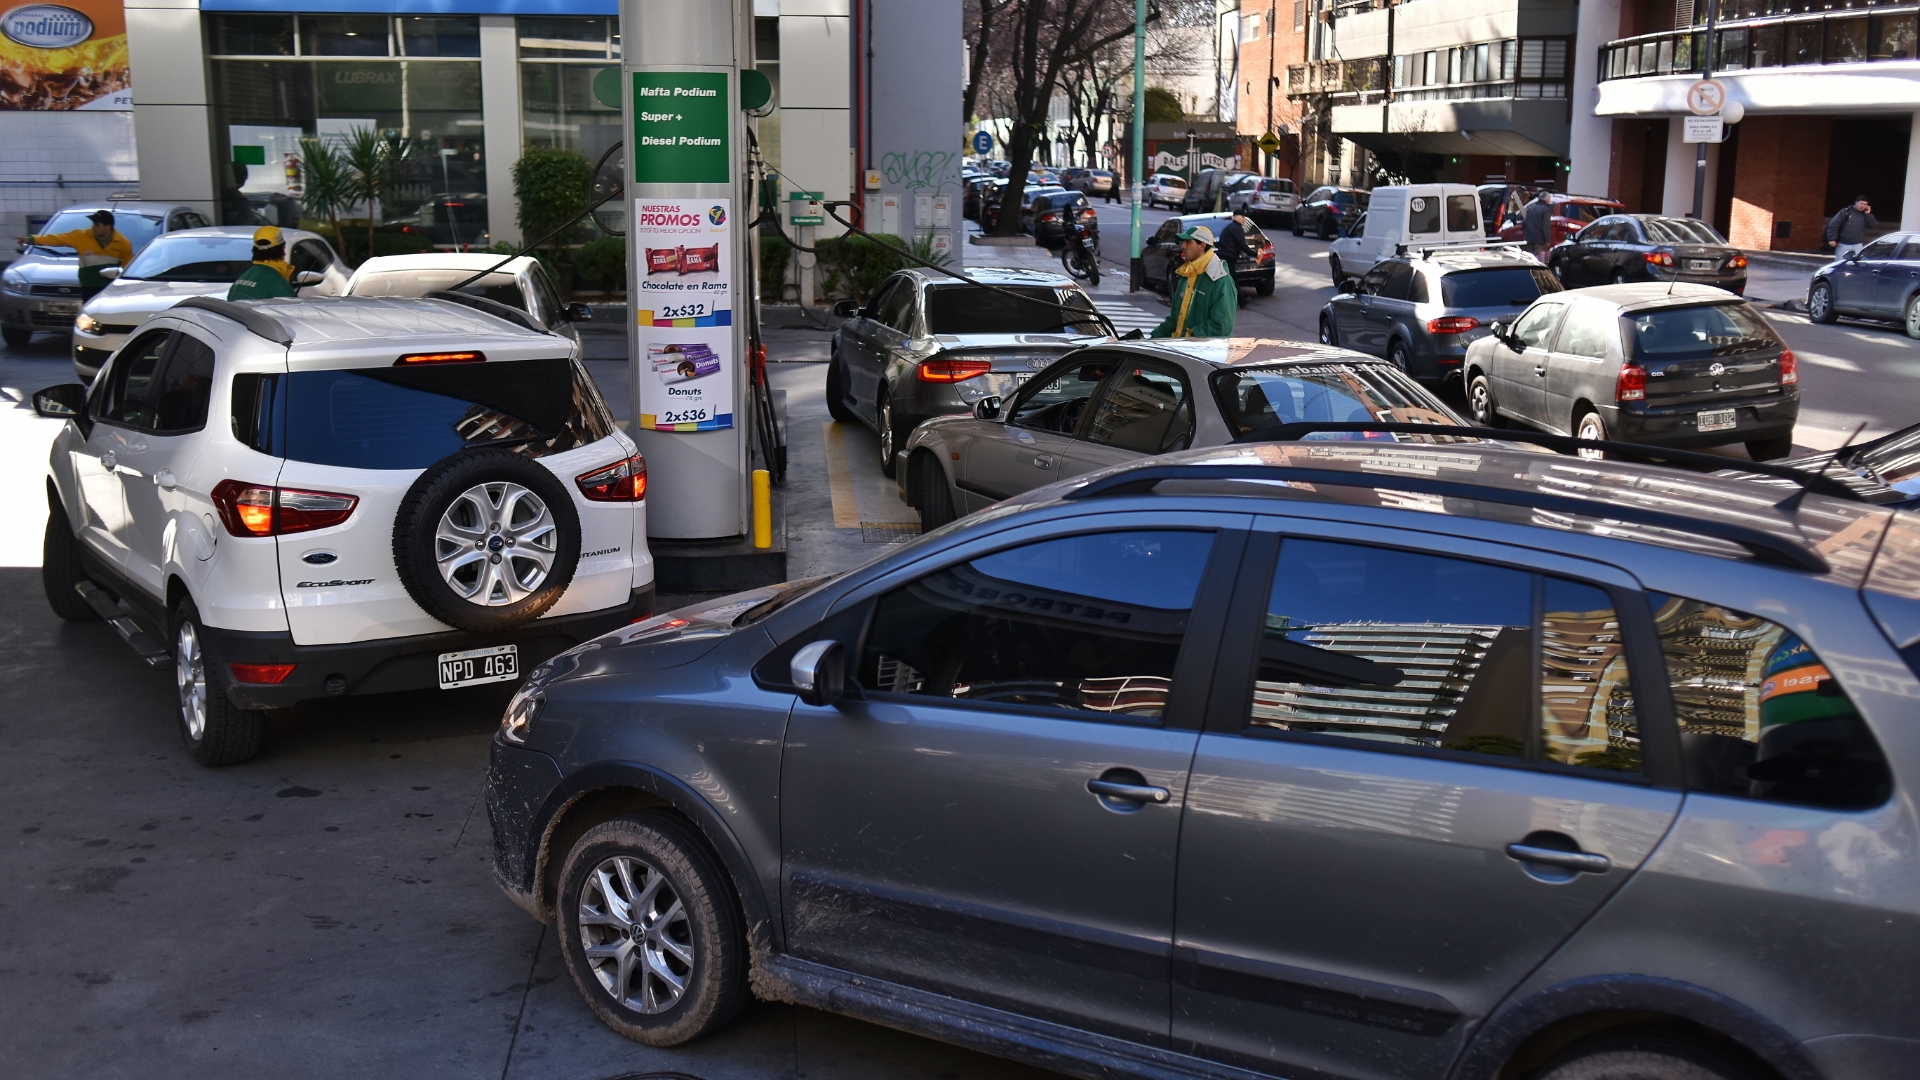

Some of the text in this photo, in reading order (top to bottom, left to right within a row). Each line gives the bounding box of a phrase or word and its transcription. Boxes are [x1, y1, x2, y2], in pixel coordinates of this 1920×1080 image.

[13, 14, 81, 37] podium
[335, 71, 397, 84] LUBRAX
[640, 87, 717, 97] Nafta Podium
[641, 111, 674, 123] Super
[641, 136, 722, 146] Diesel Podium
[979, 135, 988, 150] E
[1163, 156, 1185, 167] DALE
[1203, 153, 1228, 168] VERDE
[641, 205, 681, 213] NUESTRAS
[1413, 201, 1424, 210] 110
[640, 213, 701, 226] PROMOS
[686, 257, 702, 265] RAMA
[641, 281, 684, 290] Chocolate
[701, 282, 728, 290] Rama
[663, 304, 705, 317] 2x$32
[695, 358, 719, 369] Donuts
[668, 387, 702, 396] Donuts
[665, 408, 706, 422] 2x$36
[1700, 413, 1734, 426] IDB 102
[580, 546, 621, 558] ITANIUM
[463, 649, 494, 658] ARGENTINA
[442, 655, 515, 682] NPD 463
